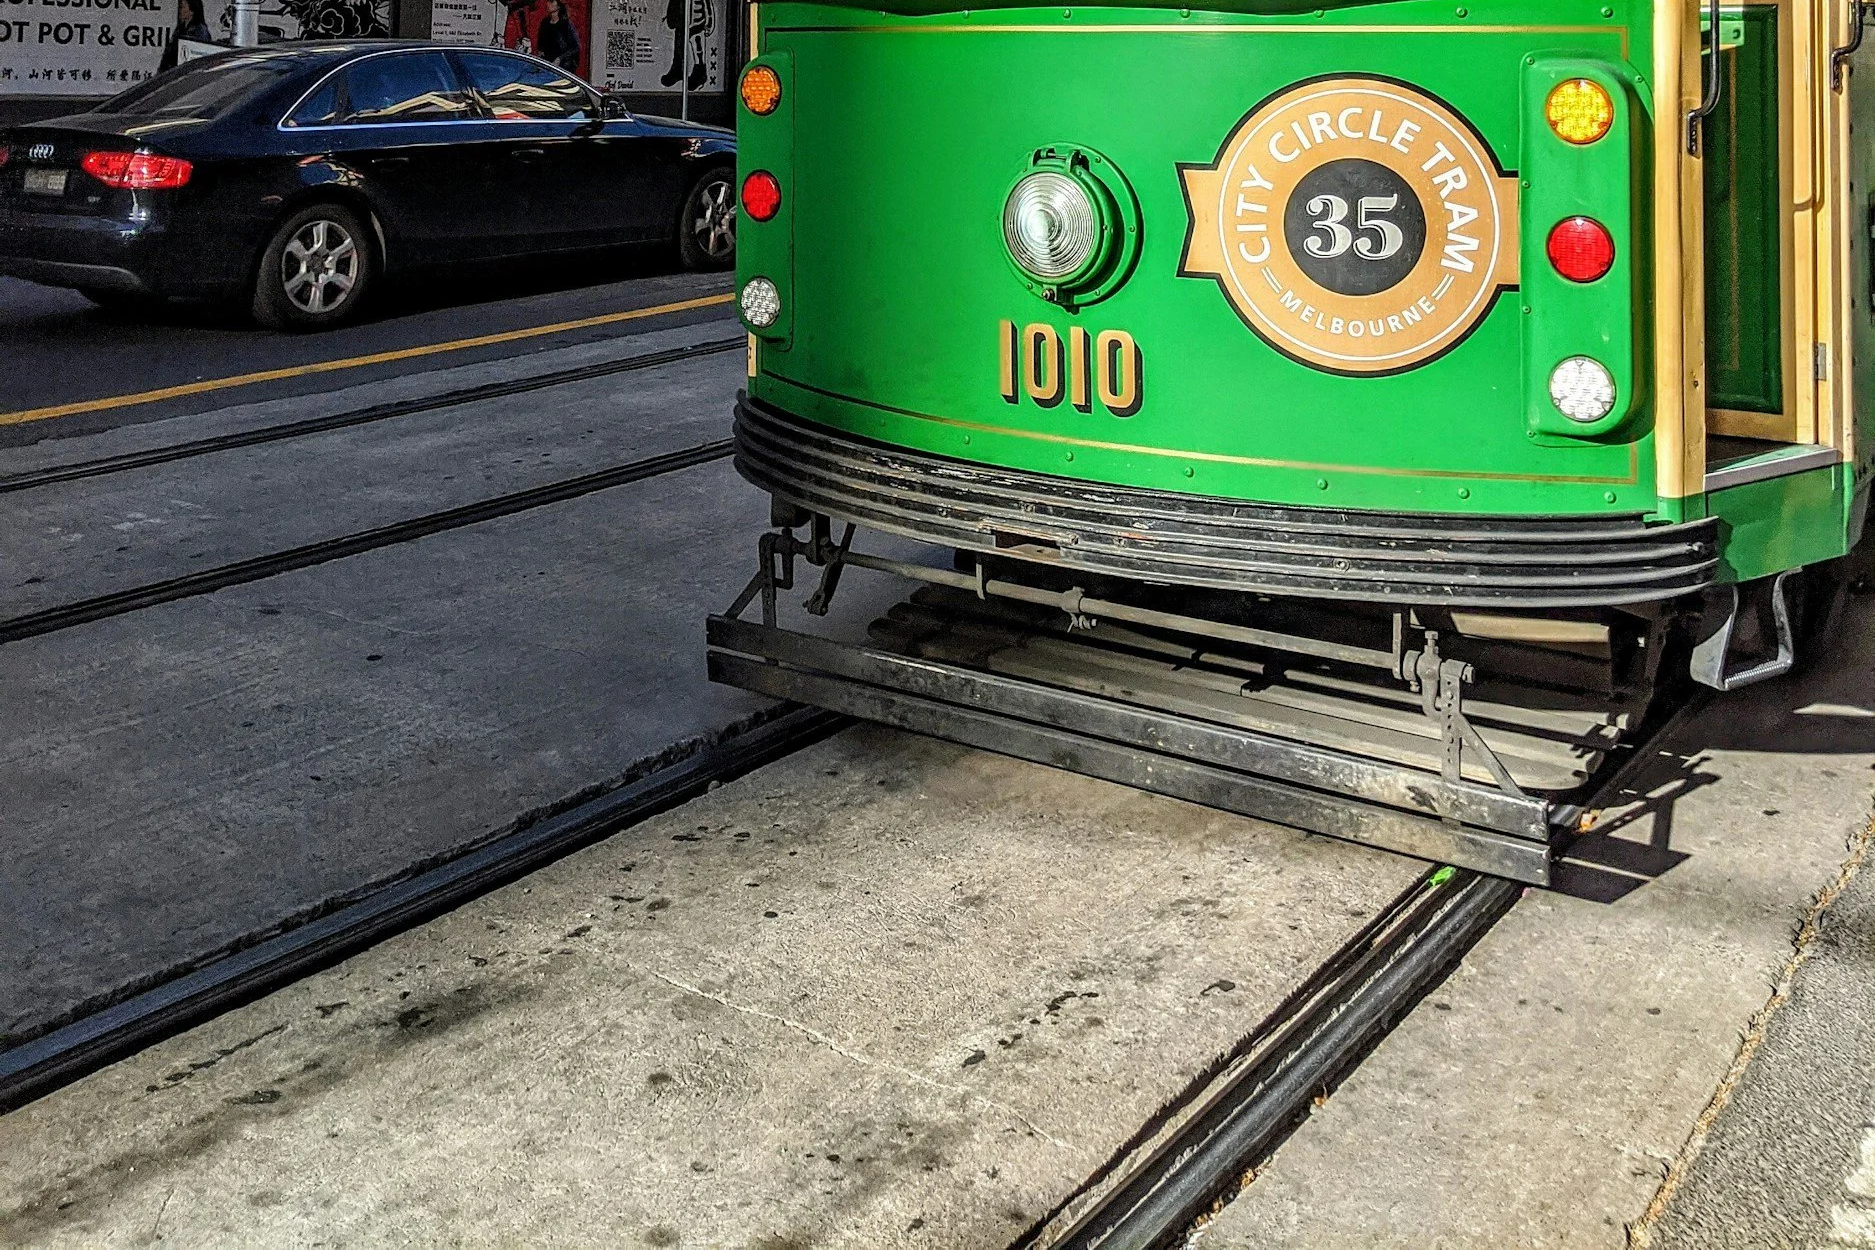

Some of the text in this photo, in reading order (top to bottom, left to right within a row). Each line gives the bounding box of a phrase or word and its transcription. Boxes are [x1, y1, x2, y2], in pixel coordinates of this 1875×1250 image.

[38, 22, 91, 46] POT
[97, 23, 116, 47] &
[1235, 106, 1482, 274] CITY CIRCLE TRAM
[1303, 193, 1404, 261] 35
[1279, 288, 1437, 338] MELBOURNE
[999, 318, 1145, 418] 1010
